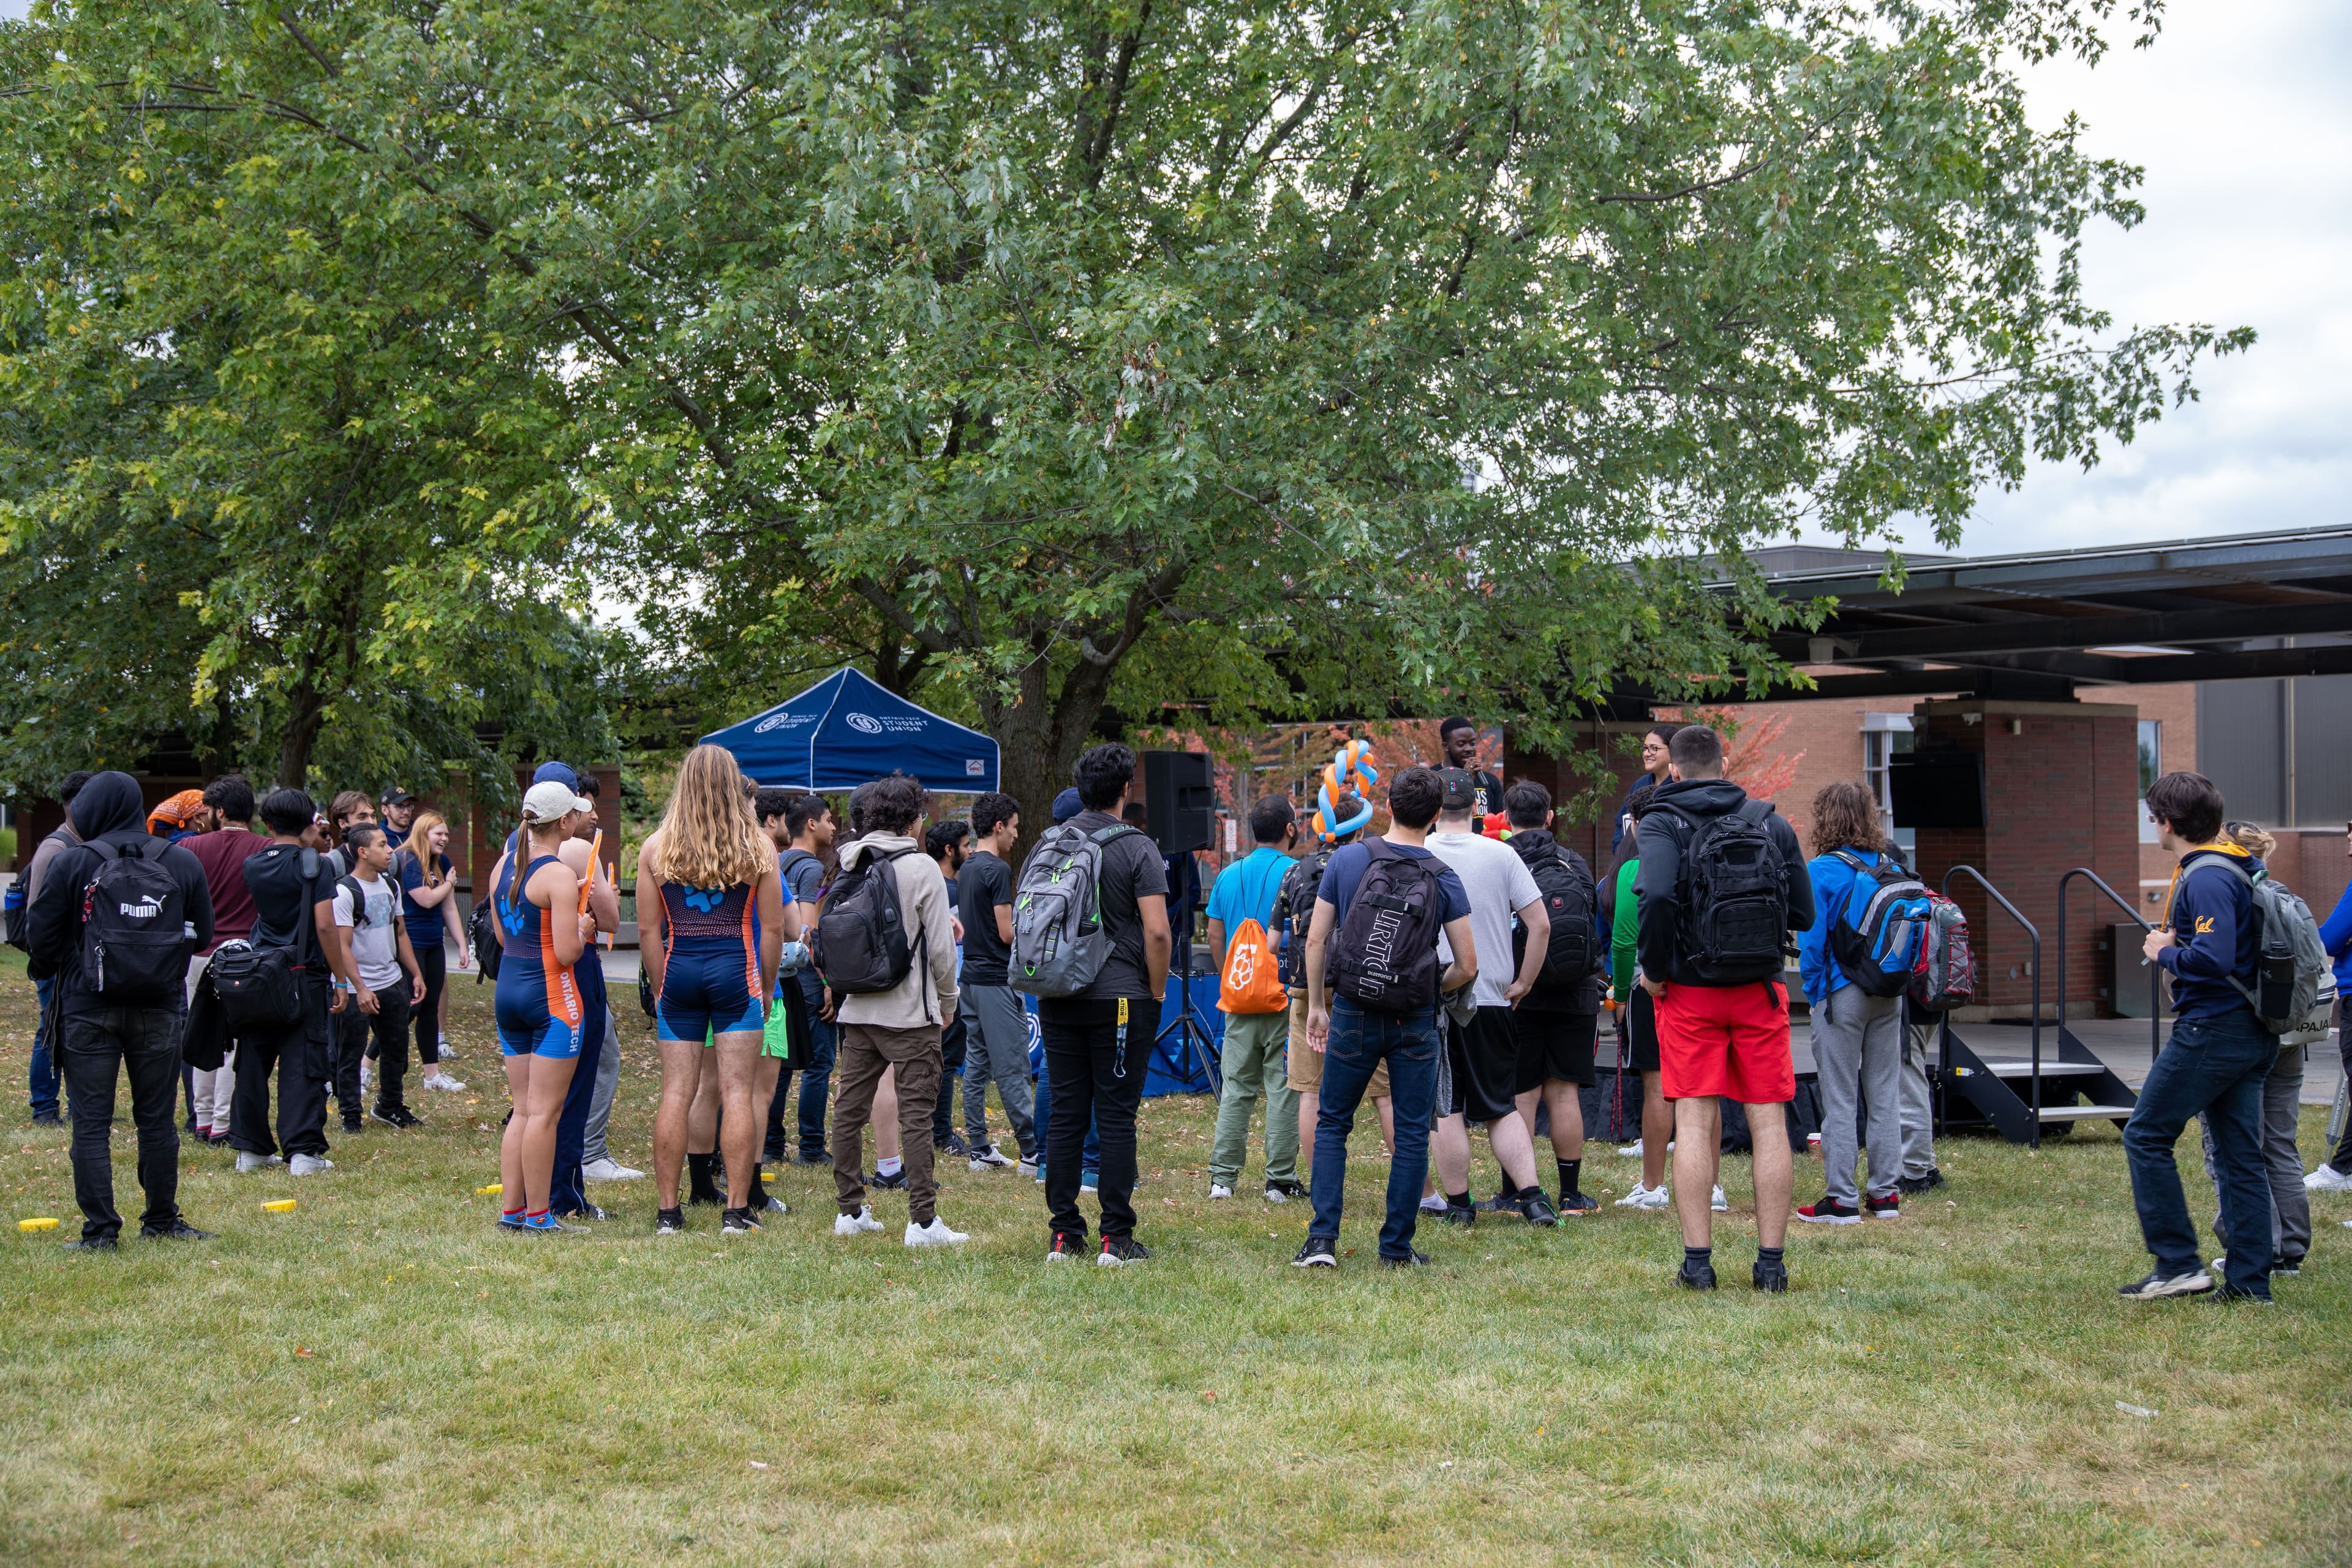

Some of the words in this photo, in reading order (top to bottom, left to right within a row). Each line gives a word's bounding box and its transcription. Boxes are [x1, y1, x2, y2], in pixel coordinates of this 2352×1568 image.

[120, 903, 157, 918] PUMA
[560, 971, 579, 1020] ONTARIO
[569, 1022, 579, 1052] TECH
